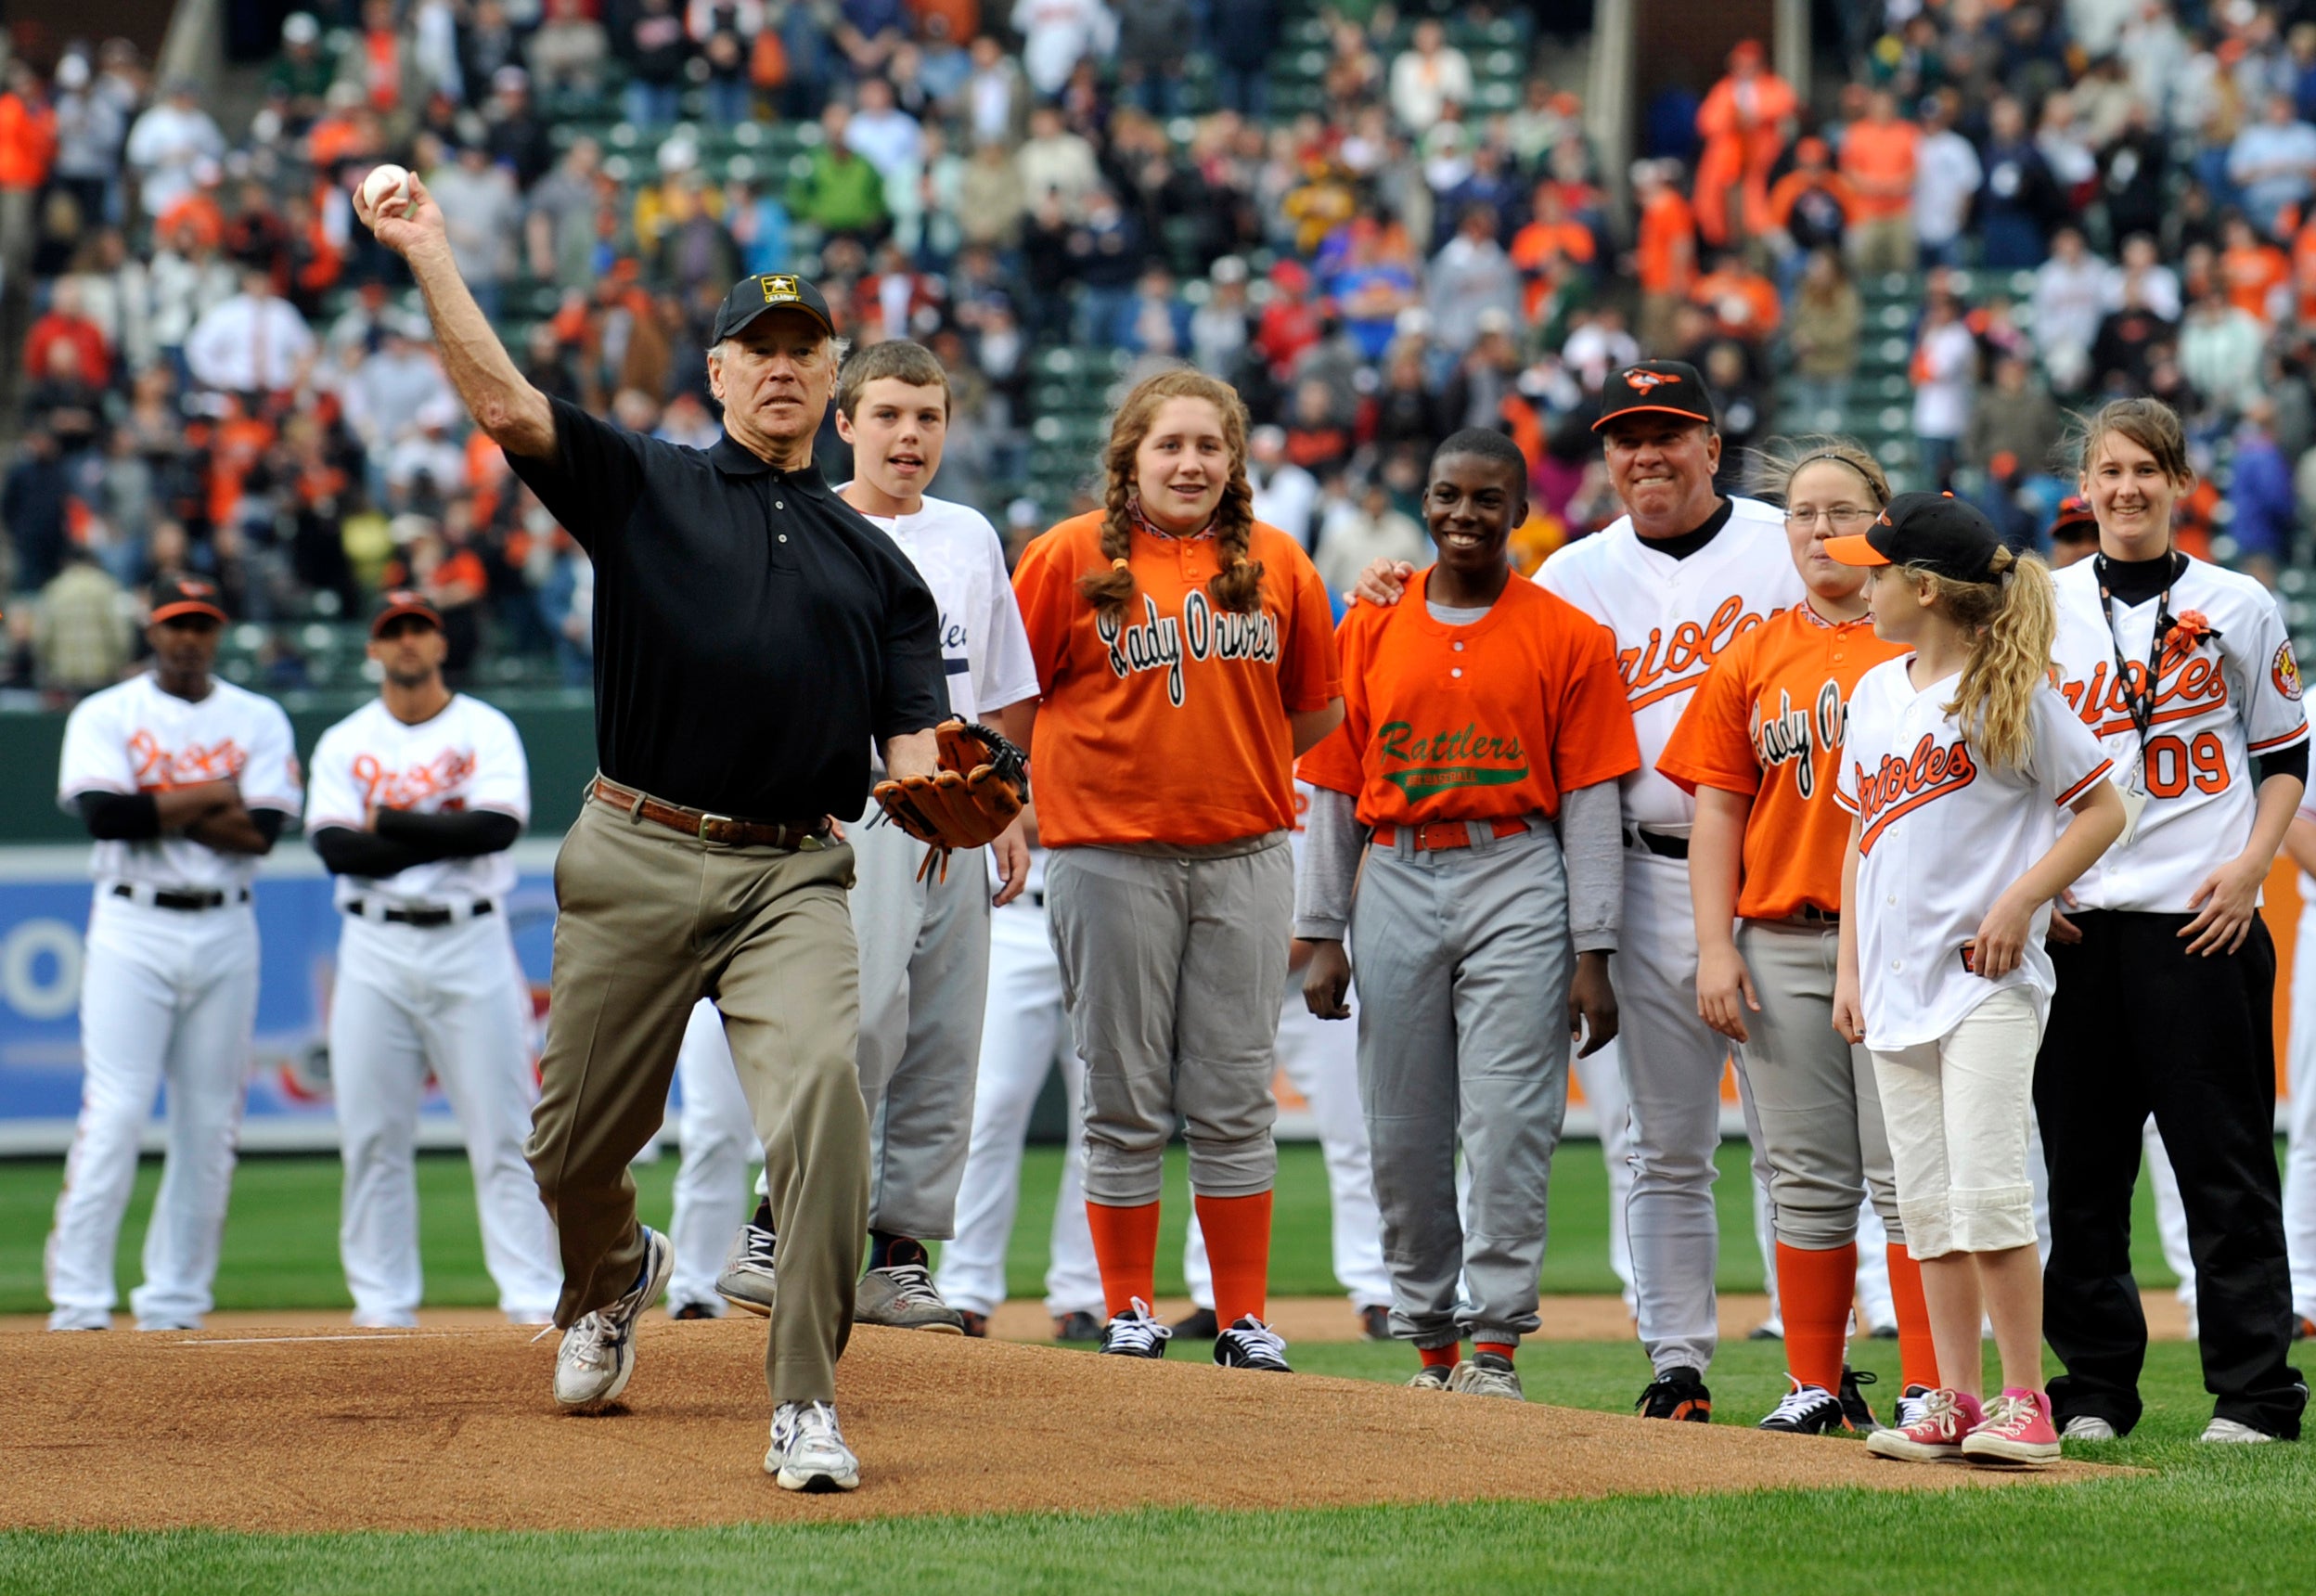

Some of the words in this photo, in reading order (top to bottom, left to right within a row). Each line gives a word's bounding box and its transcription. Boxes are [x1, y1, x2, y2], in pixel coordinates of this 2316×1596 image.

[1097, 593, 1185, 708] Lady
[1598, 595, 1785, 696] riole
[2048, 642, 2225, 725] rioles
[1378, 720, 1525, 766] Rattlers
[2144, 731, 2231, 799] 09
